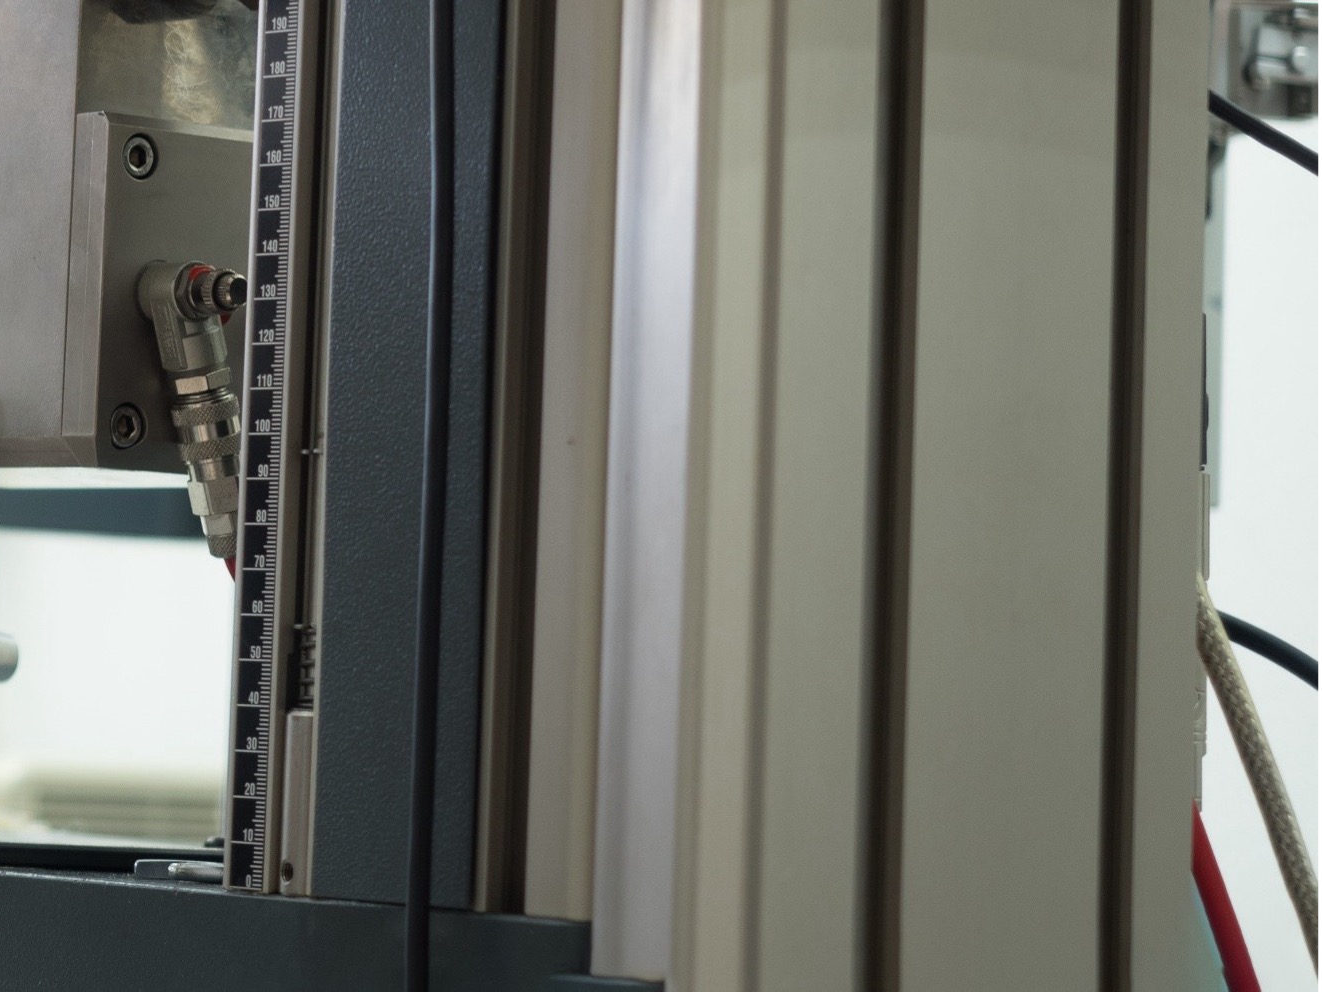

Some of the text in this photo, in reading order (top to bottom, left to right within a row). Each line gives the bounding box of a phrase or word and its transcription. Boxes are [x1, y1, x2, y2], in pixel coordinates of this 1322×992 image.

[272, 17, 287, 30] 190
[270, 61, 285, 74] 180
[268, 106, 283, 118] 170
[266, 150, 281, 163] 160
[264, 195, 279, 208] 150
[262, 239, 277, 252] 140
[261, 284, 276, 297] 130
[259, 329, 274, 342] 120
[257, 374, 272, 387] 110
[255, 419, 270, 432] 100
[258, 464, 268, 477] 90
[256, 510, 266, 522] 80
[254, 555, 265, 568] 70
[252, 600, 263, 613] 60
[250, 646, 261, 658] 50
[248, 691, 259, 704] 40
[246, 737, 257, 750] 30
[244, 783, 255, 795] 20
[243, 829, 253, 841] 10
[246, 874, 251, 887] 0
